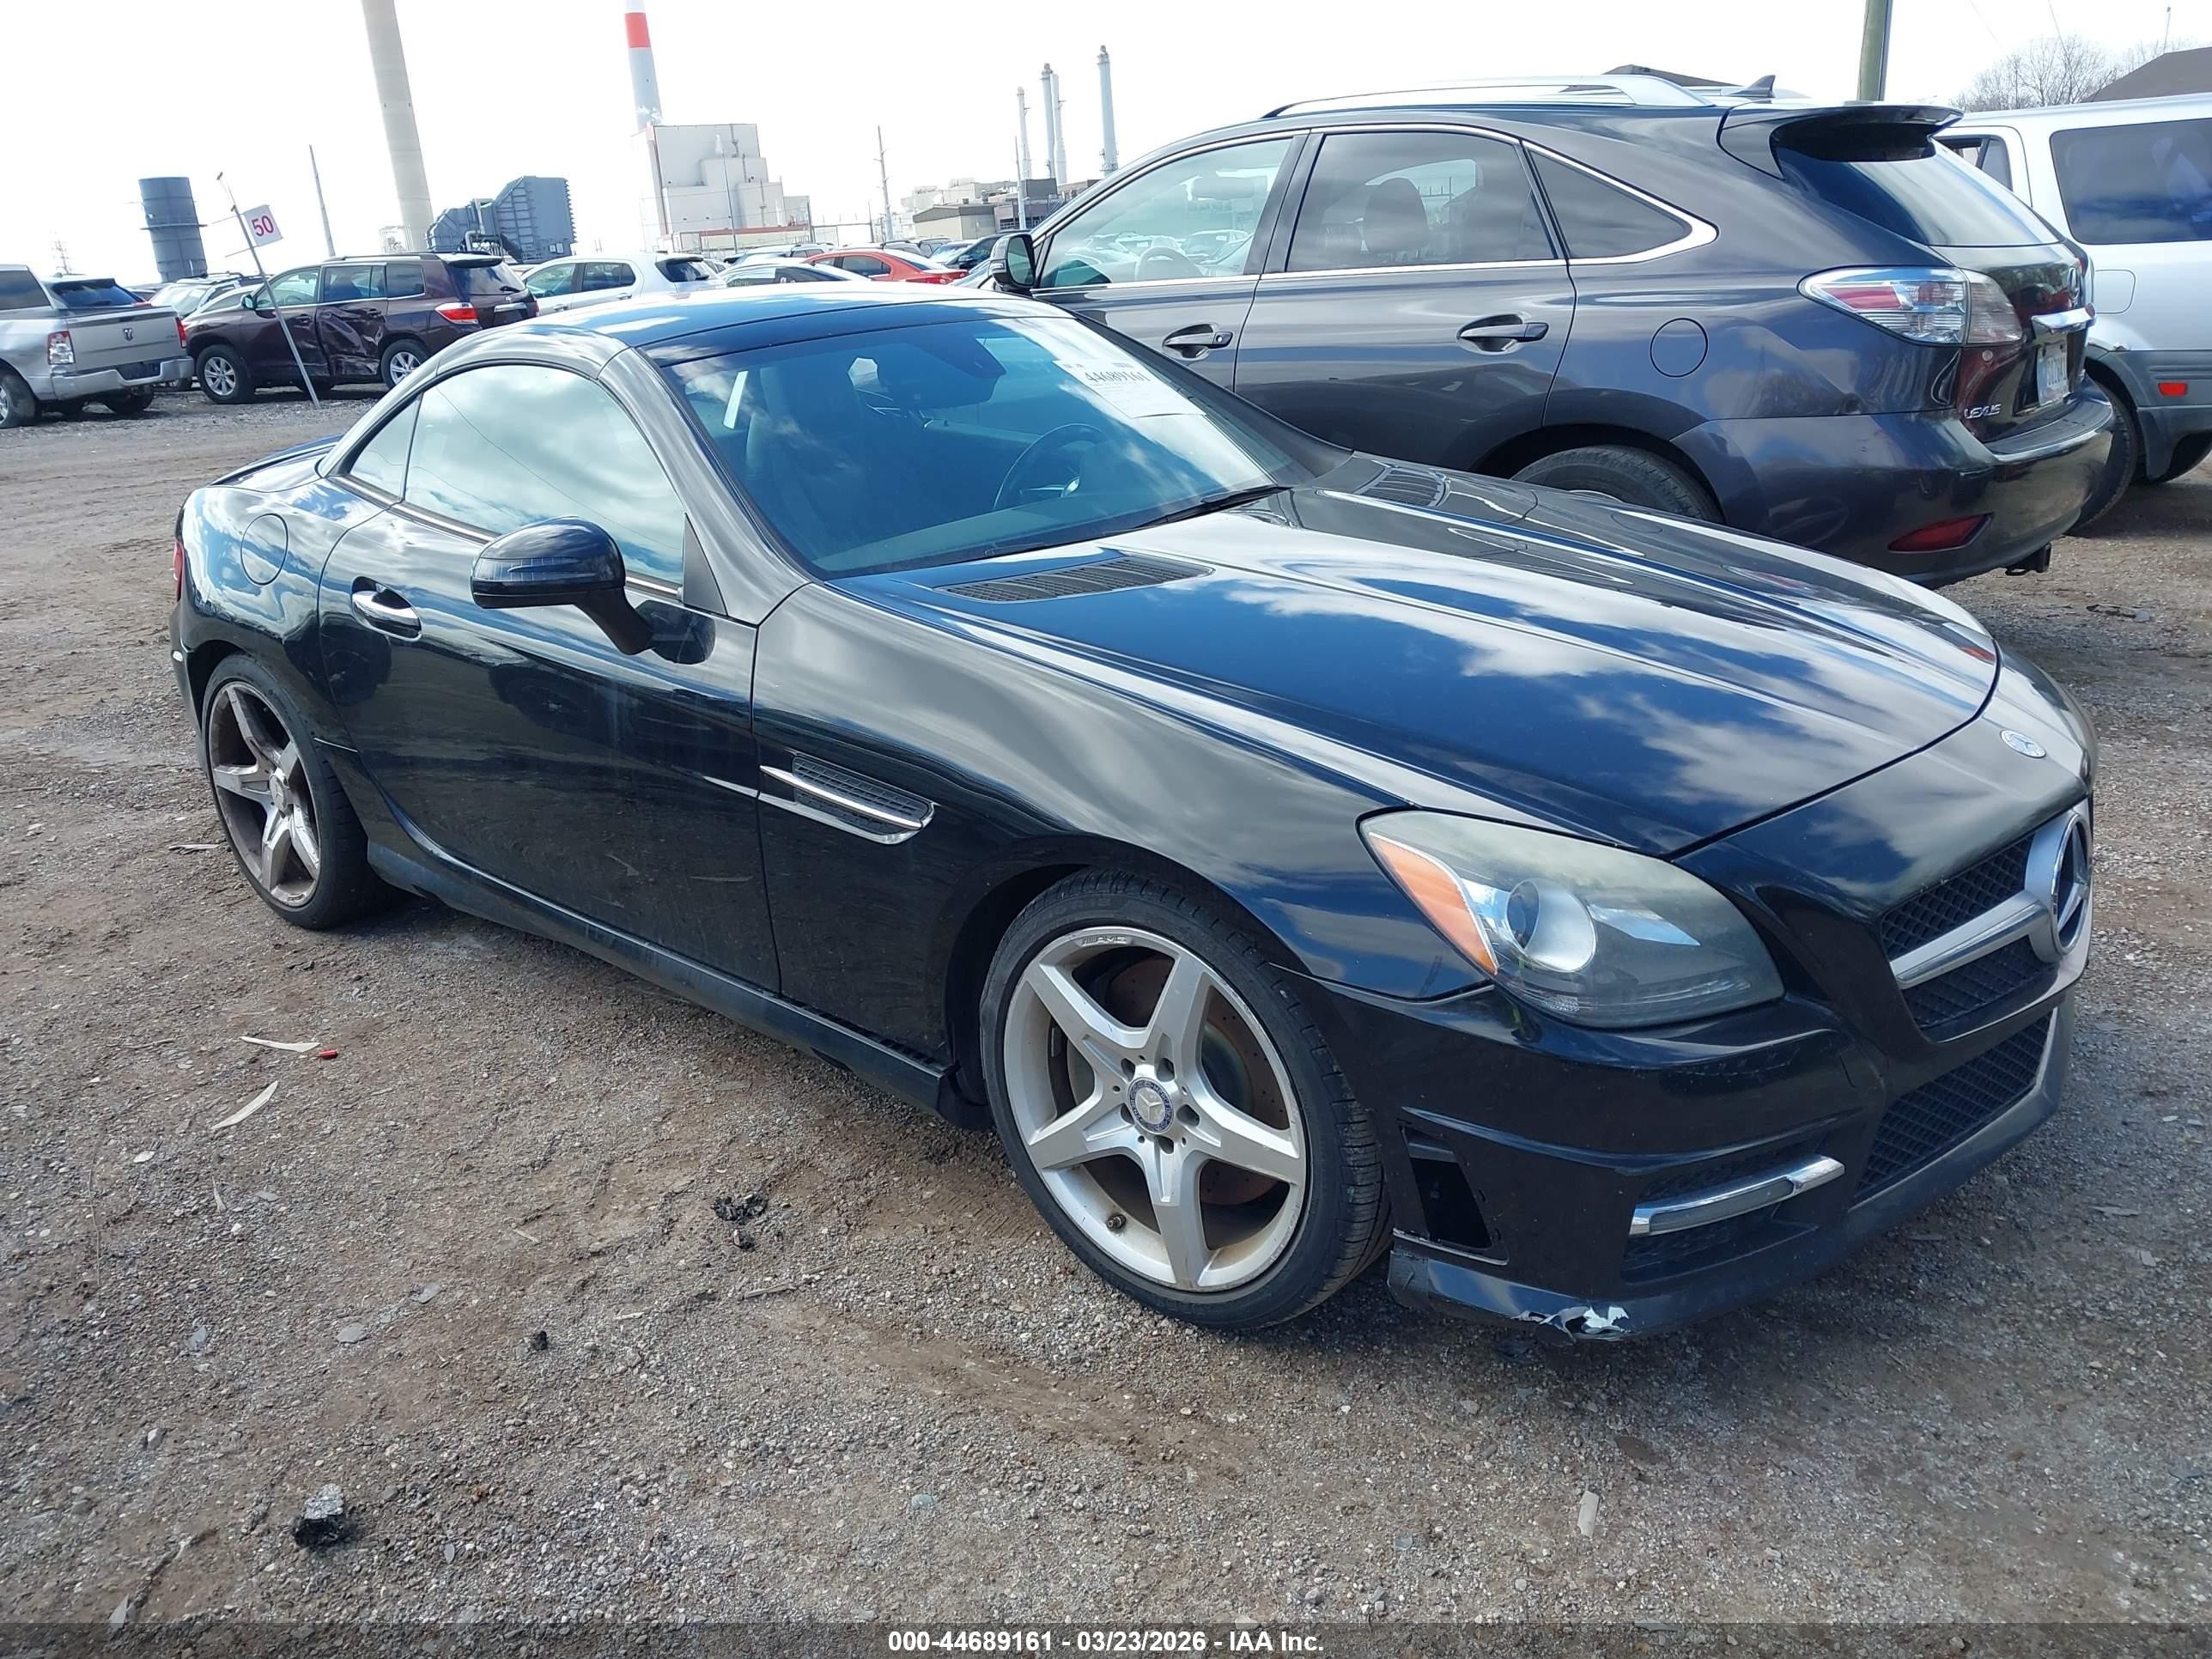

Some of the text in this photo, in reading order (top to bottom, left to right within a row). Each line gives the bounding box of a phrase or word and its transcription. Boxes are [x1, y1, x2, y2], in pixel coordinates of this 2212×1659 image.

[252, 215, 274, 237] 50
[1085, 370, 1152, 383] 44689161
[1964, 404, 2002, 419] LEXUS
